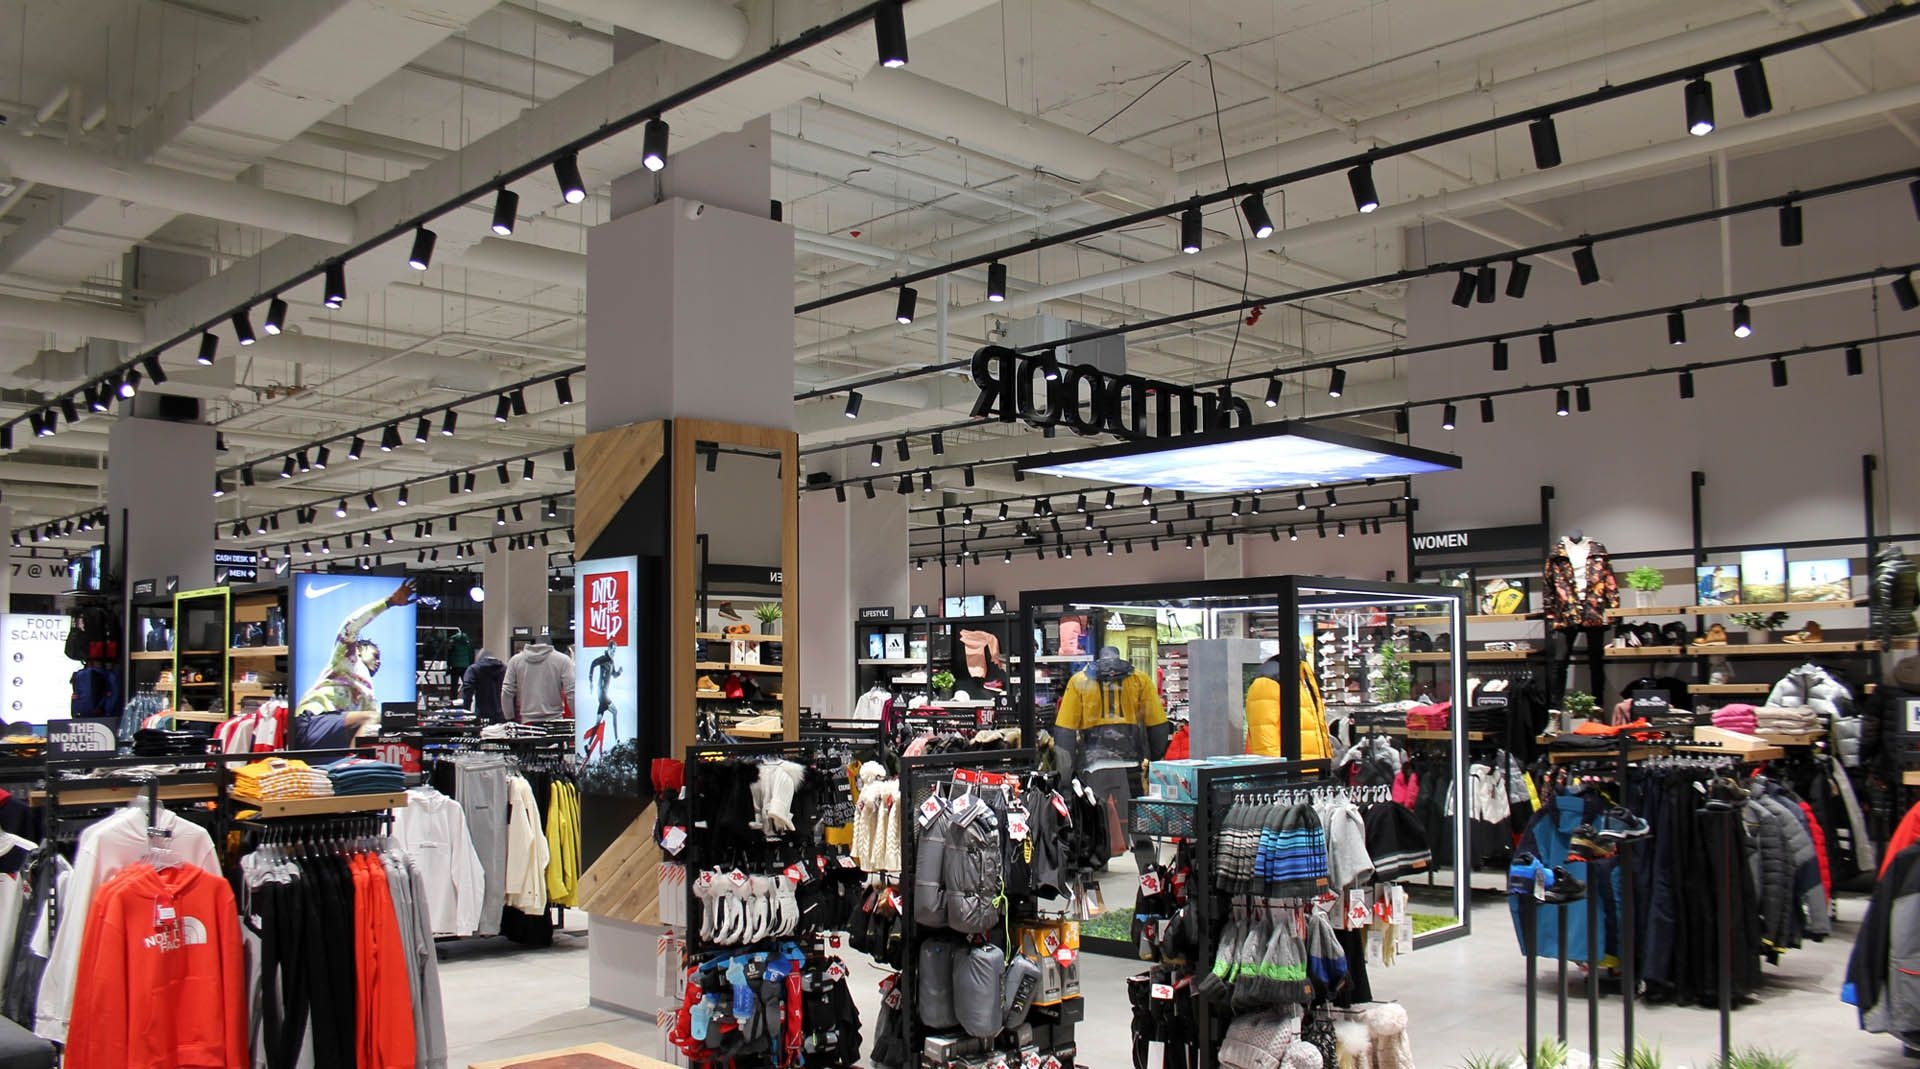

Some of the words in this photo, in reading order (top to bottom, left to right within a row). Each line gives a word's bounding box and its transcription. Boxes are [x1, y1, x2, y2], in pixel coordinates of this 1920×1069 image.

[1413, 533, 1468, 550] WOMEN
[12, 564, 22, 577] 7
[28, 564, 42, 578] @
[591, 576, 617, 603] INTO
[607, 600, 619, 613] THE
[862, 610, 889, 619] LIFESTYLE
[27, 618, 62, 629] FOOT
[590, 605, 622, 640] WILD
[11, 630, 67, 641] SCANNE
[70, 723, 93, 733] THE
[51, 733, 93, 743] NORTH
[63, 743, 95, 752] FACE
[374, 745, 411, 764] 50%
